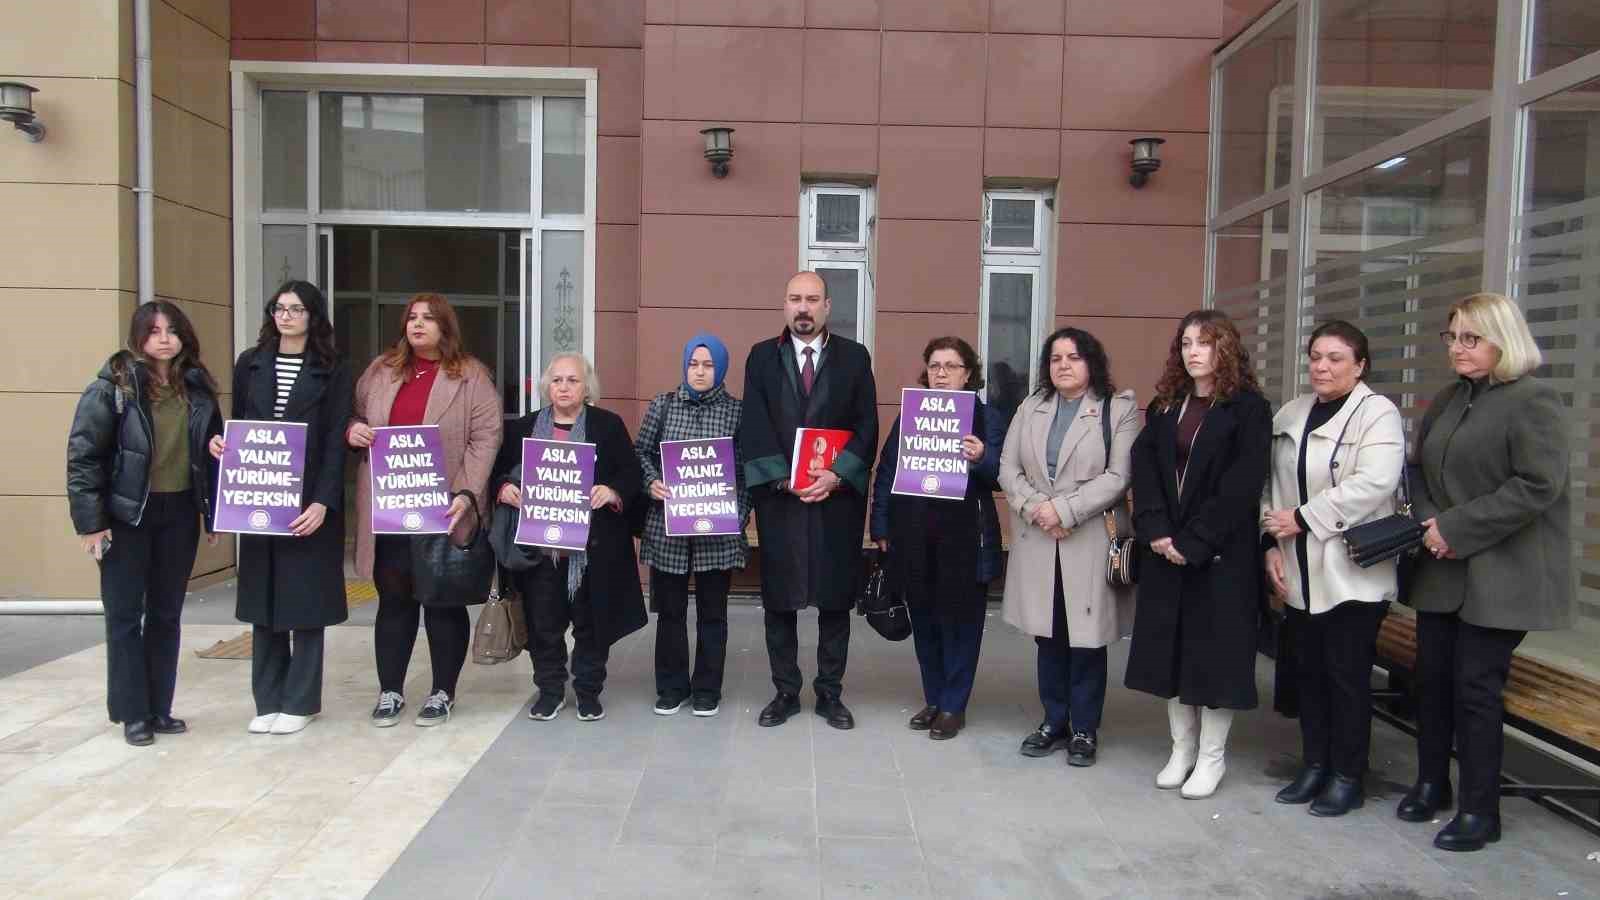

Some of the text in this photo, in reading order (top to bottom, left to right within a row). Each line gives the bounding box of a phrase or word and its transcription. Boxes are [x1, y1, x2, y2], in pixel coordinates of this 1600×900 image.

[920, 397, 956, 412] ASLA
[914, 417, 960, 433] YALNIZ
[245, 429, 287, 445] ASLA
[389, 433, 425, 448] ASLA
[238, 449, 292, 466] YALNIZ
[384, 453, 434, 469] YALNIZ
[541, 448, 577, 464] ASLA
[681, 446, 717, 460] ASLA
[676, 464, 724, 479] YALNIZ
[902, 456, 967, 473] YECEKSİN
[536, 467, 582, 484] YALNIZ
[223, 490, 300, 507] YECEKSİN
[376, 490, 448, 509] YECEKSİN
[524, 505, 590, 524] YECEKSİN
[669, 500, 736, 516] YECEKSİN
